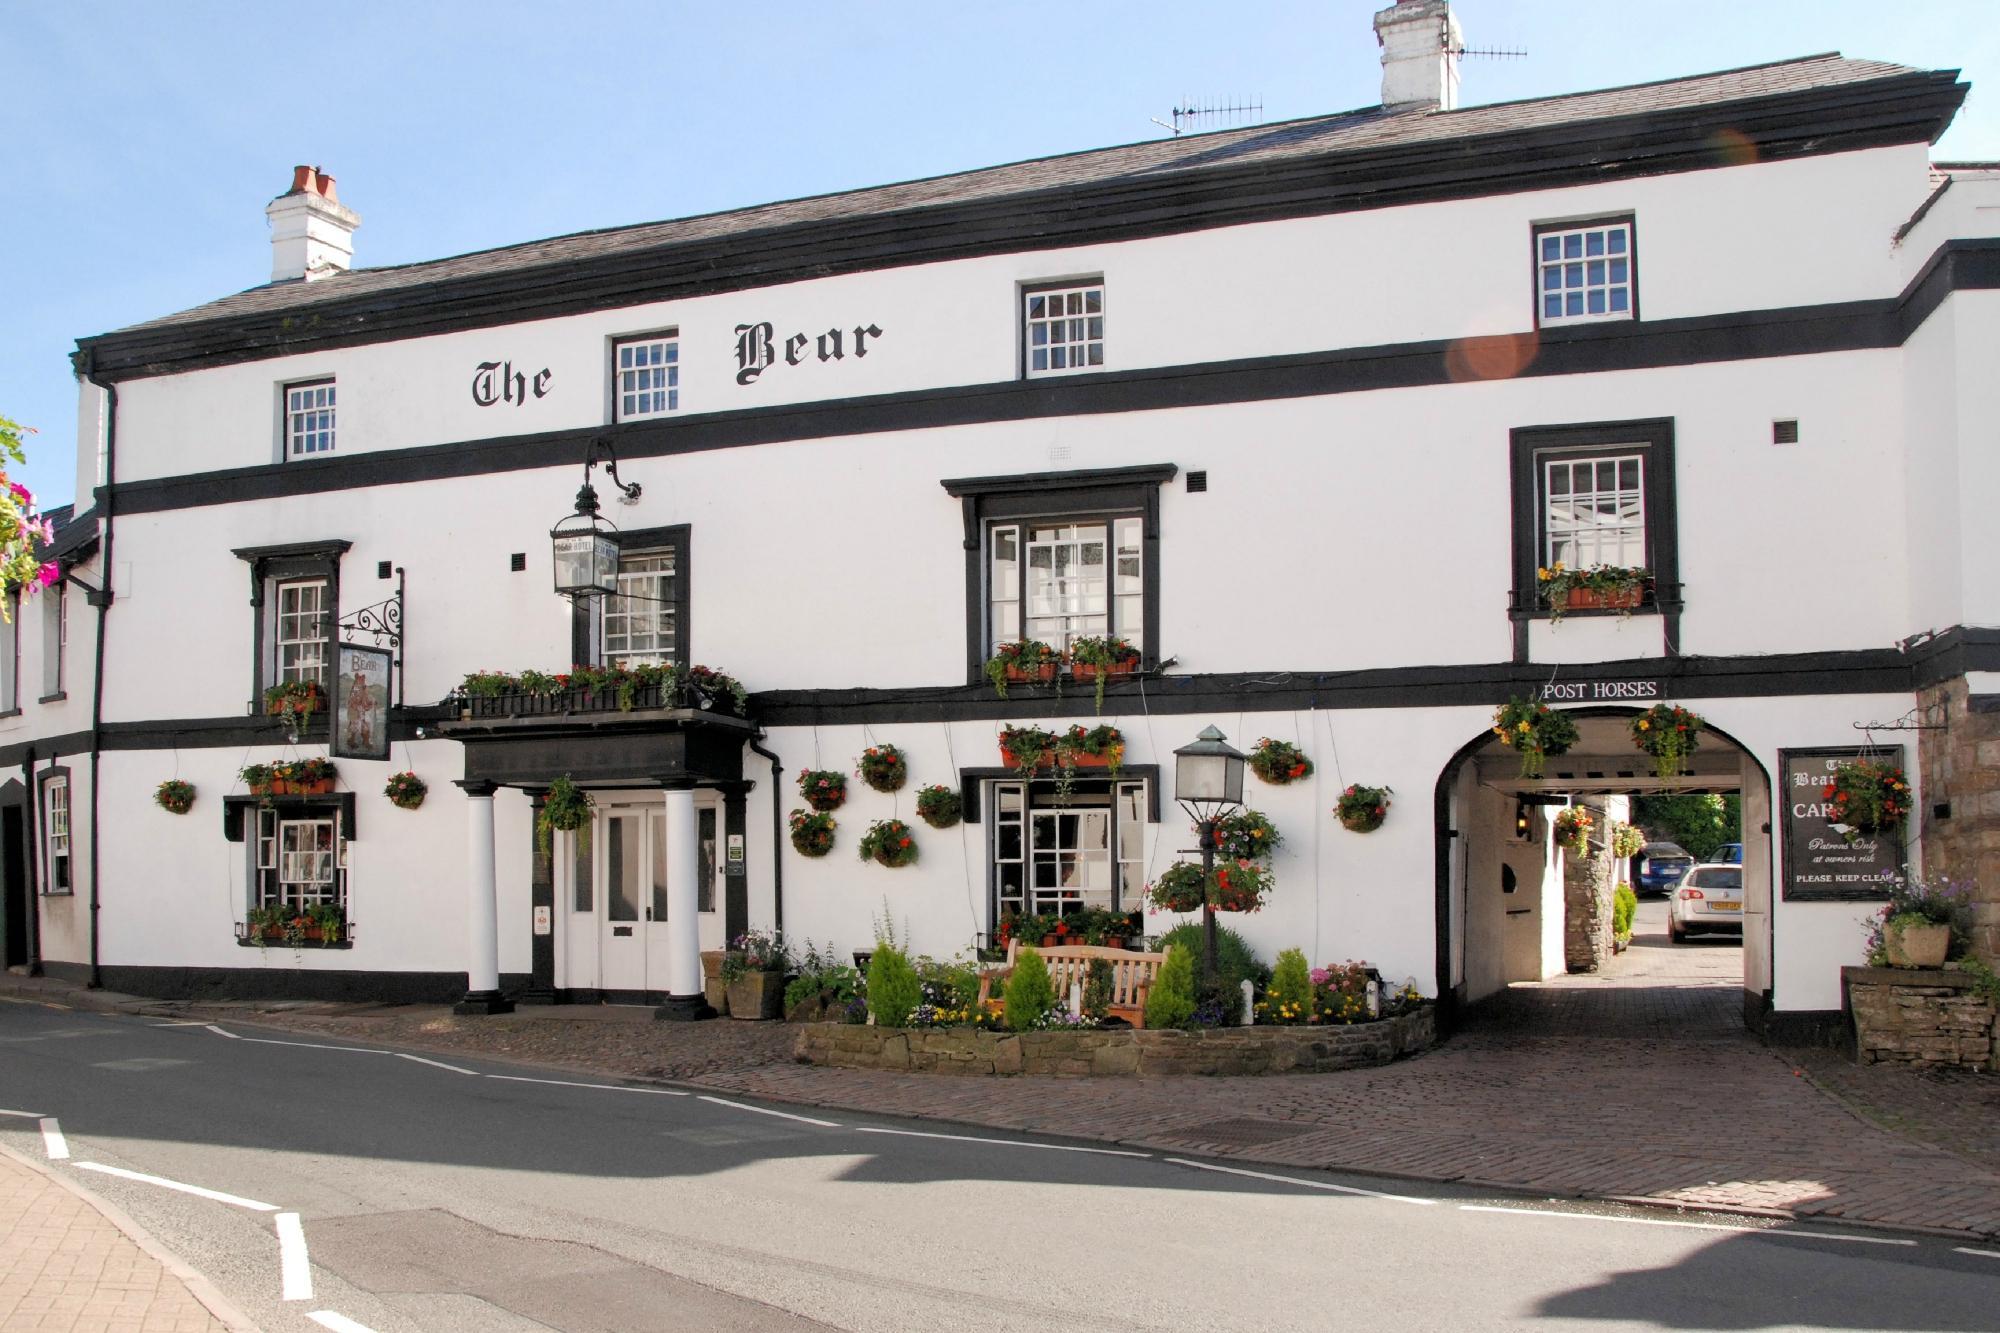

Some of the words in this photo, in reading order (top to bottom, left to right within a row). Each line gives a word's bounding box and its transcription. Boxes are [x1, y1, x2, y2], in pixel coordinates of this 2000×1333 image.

[471, 359, 555, 407] The
[733, 321, 884, 386] Bear
[574, 541, 592, 551] HOTEL
[351, 655, 377, 672] BEAR
[1543, 683, 1587, 699] POST
[1594, 681, 1657, 698] HORSES
[1808, 838, 1849, 850] Patrons
[1851, 837, 1879, 853] Only
[1813, 855, 1823, 863] at
[1824, 855, 1857, 863] owners
[1858, 853, 1876, 863] risk
[1796, 874, 1833, 882] PLEASE
[1835, 874, 1860, 882] KEEP
